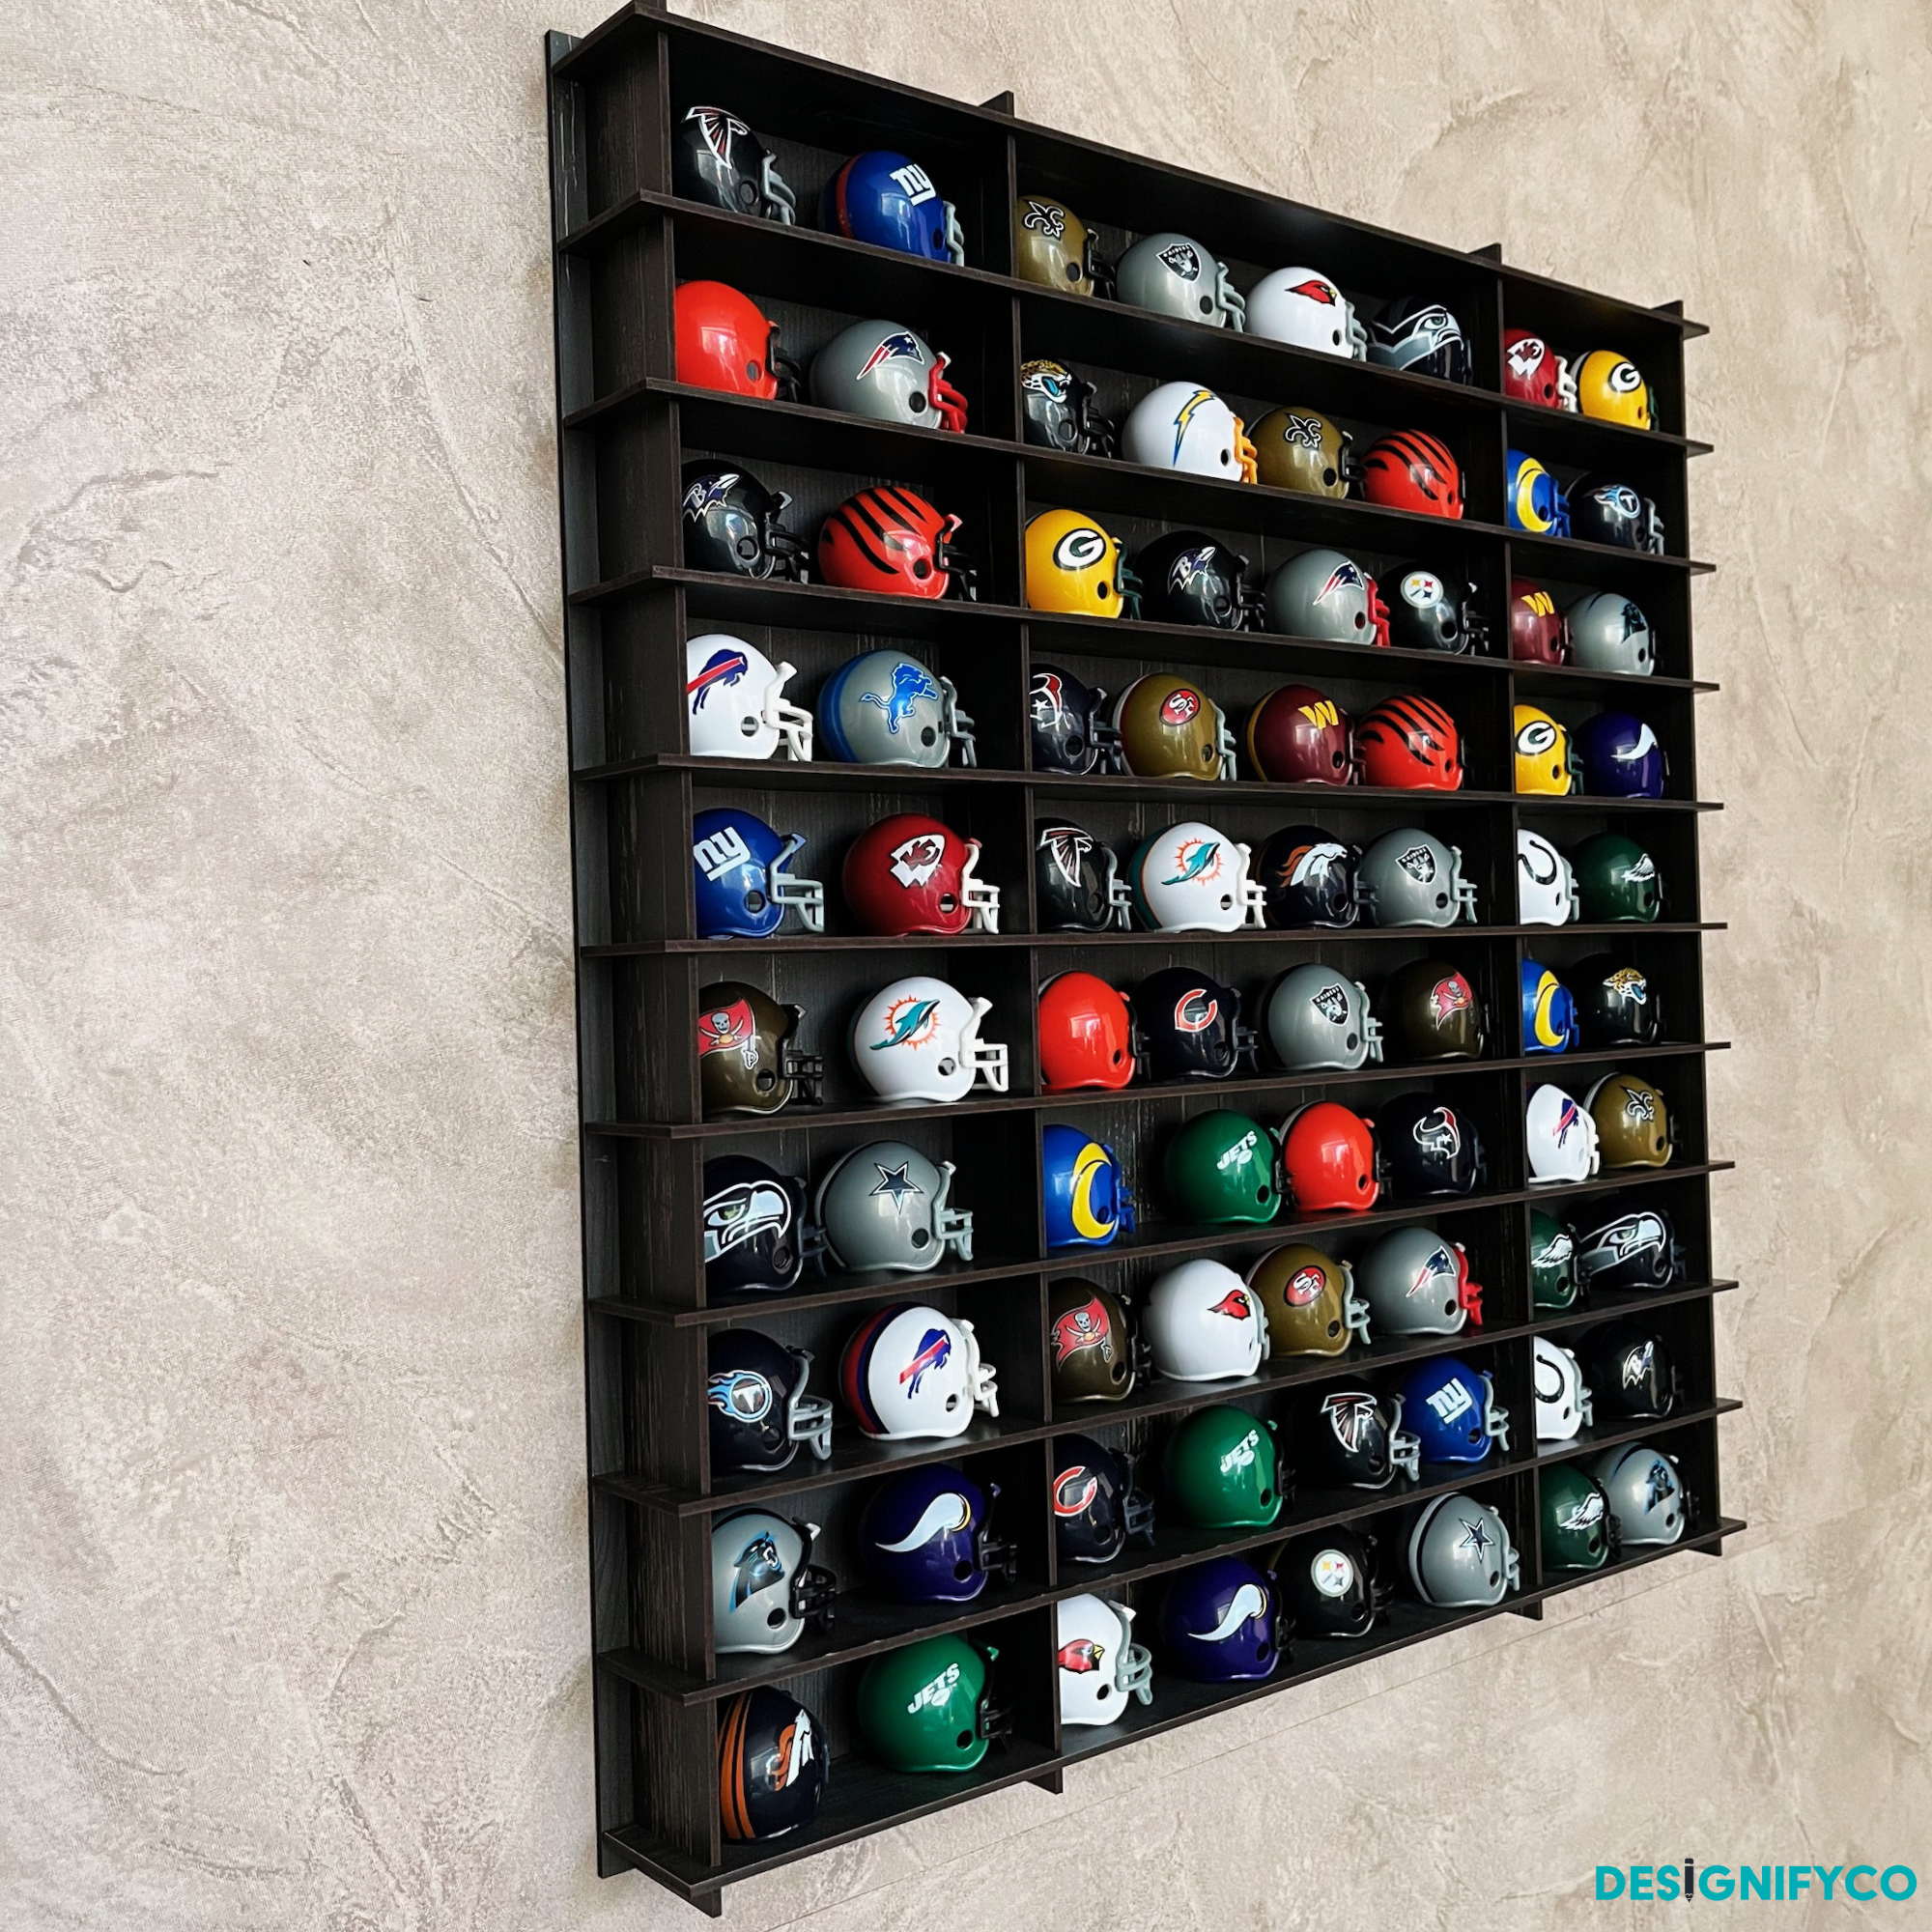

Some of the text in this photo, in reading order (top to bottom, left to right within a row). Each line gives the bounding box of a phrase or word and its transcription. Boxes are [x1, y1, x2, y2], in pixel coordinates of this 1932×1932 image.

[1161, 242, 1192, 258] RAIDERS
[1611, 364, 1639, 390] G
[1622, 495, 1636, 511] T
[1059, 530, 1104, 567] G
[1521, 592, 1553, 615] W
[1168, 693, 1196, 718] SF
[1299, 700, 1339, 728] W
[1519, 723, 1554, 752] G
[1400, 845, 1429, 864] RAIDERS
[1314, 985, 1342, 1004] RAIDERS
[1176, 989, 1218, 1032] C
[1217, 1130, 1257, 1170] JETS
[1293, 1272, 1321, 1296] SF
[734, 1387, 760, 1411] T
[1220, 1430, 1260, 1474] JETS
[1054, 1466, 1097, 1517] C
[908, 1662, 960, 1715] JETS
